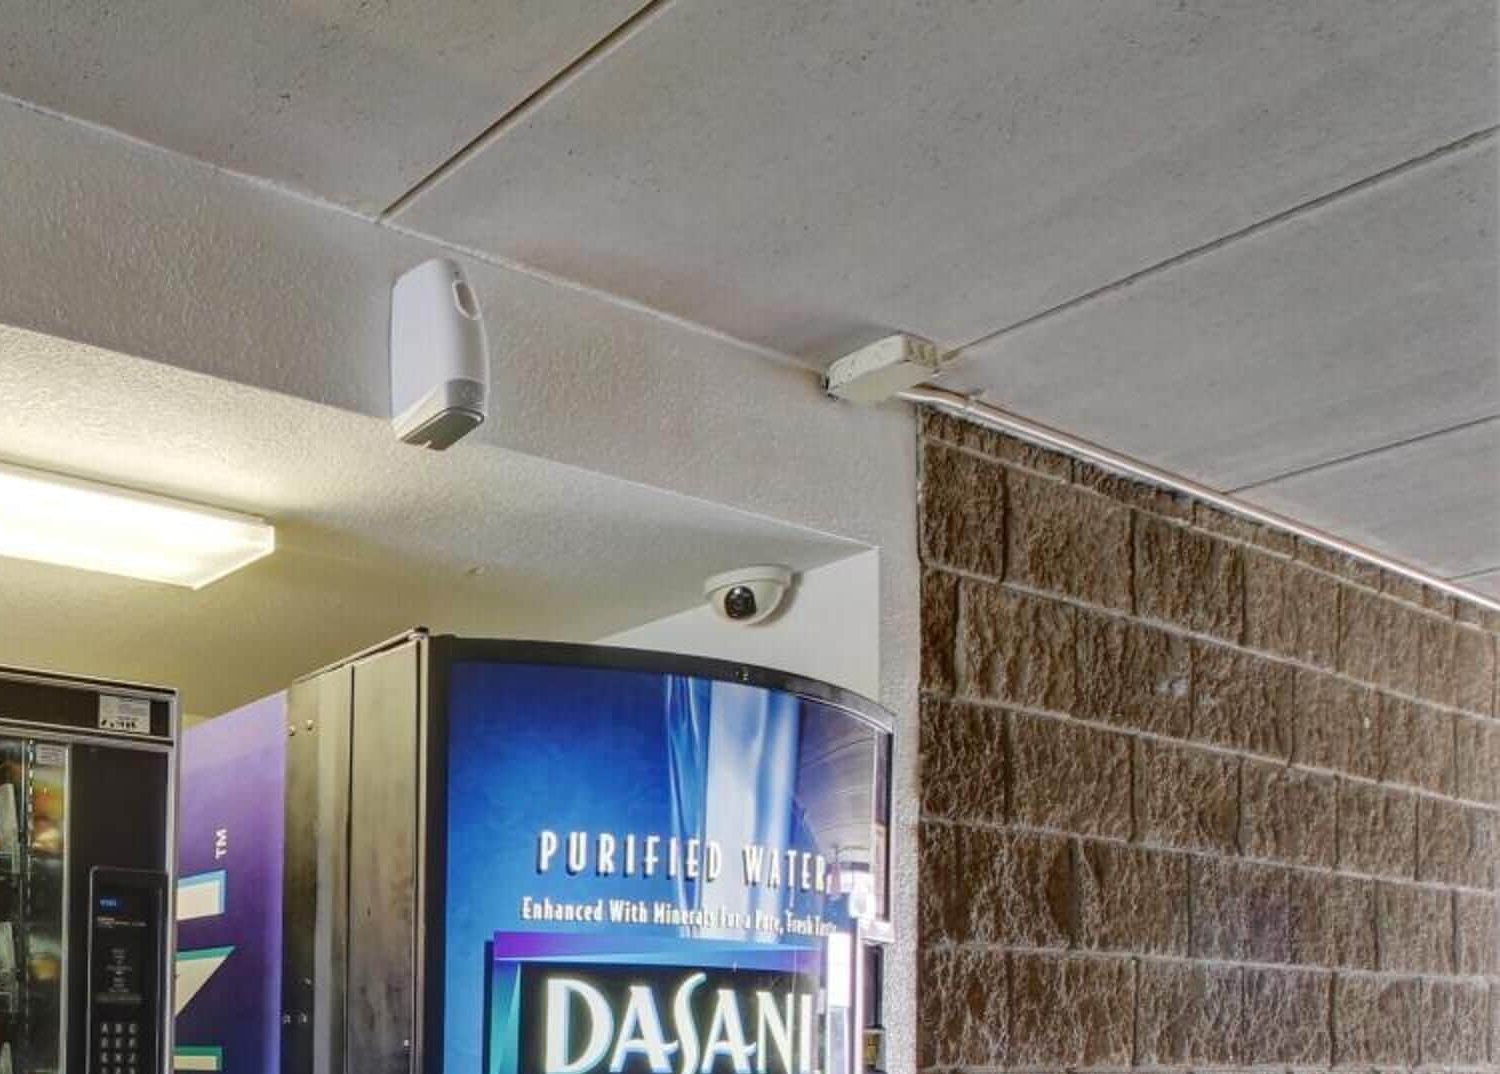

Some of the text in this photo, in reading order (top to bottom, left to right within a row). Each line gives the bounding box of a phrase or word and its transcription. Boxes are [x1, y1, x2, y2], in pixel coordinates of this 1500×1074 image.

[538, 830, 827, 894] PURIFIED WATER
[522, 895, 603, 922] Enhanced
[609, 899, 648, 924] With
